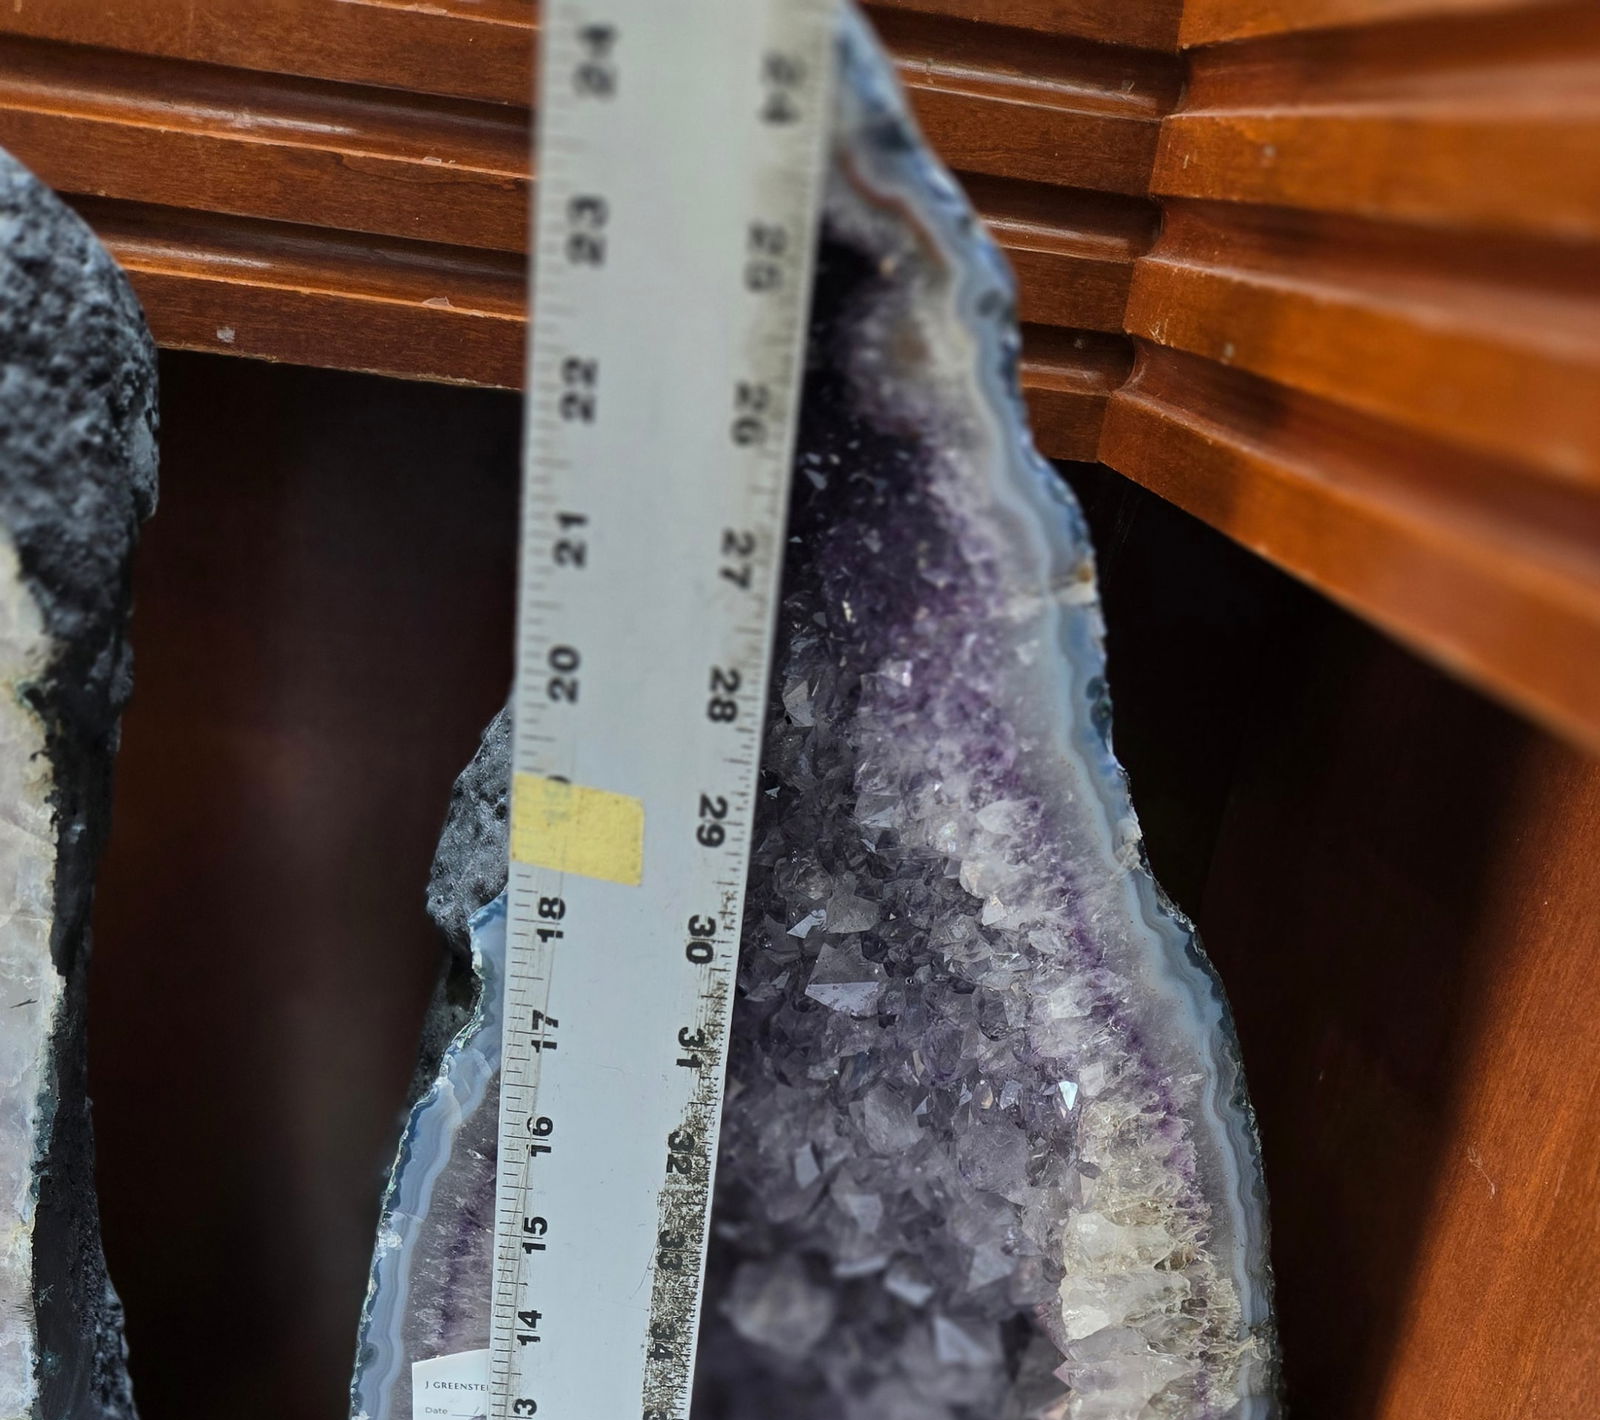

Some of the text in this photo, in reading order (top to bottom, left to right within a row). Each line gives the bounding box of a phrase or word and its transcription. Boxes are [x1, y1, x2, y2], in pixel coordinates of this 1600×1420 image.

[573, 24, 617, 98] 24
[565, 196, 608, 267] 23
[744, 222, 787, 292] 25
[560, 356, 597, 424] 22
[731, 382, 769, 446] 26
[554, 511, 588, 569] 21
[719, 528, 755, 589] 27
[547, 645, 580, 704] 20
[707, 666, 742, 724] 28
[696, 793, 728, 848] 29
[536, 897, 566, 943] 18
[686, 915, 716, 964] 30
[530, 1010, 559, 1053] 17
[676, 1027, 706, 1067] 31
[526, 1116, 553, 1157] 16
[666, 1131, 695, 1174] 32
[522, 1216, 548, 1254] 15
[657, 1230, 685, 1270] 33
[517, 1310, 542, 1346] 14
[650, 1322, 675, 1360] 34
[425, 1381, 429, 1389] J
[425, 1406, 448, 1415] Date
